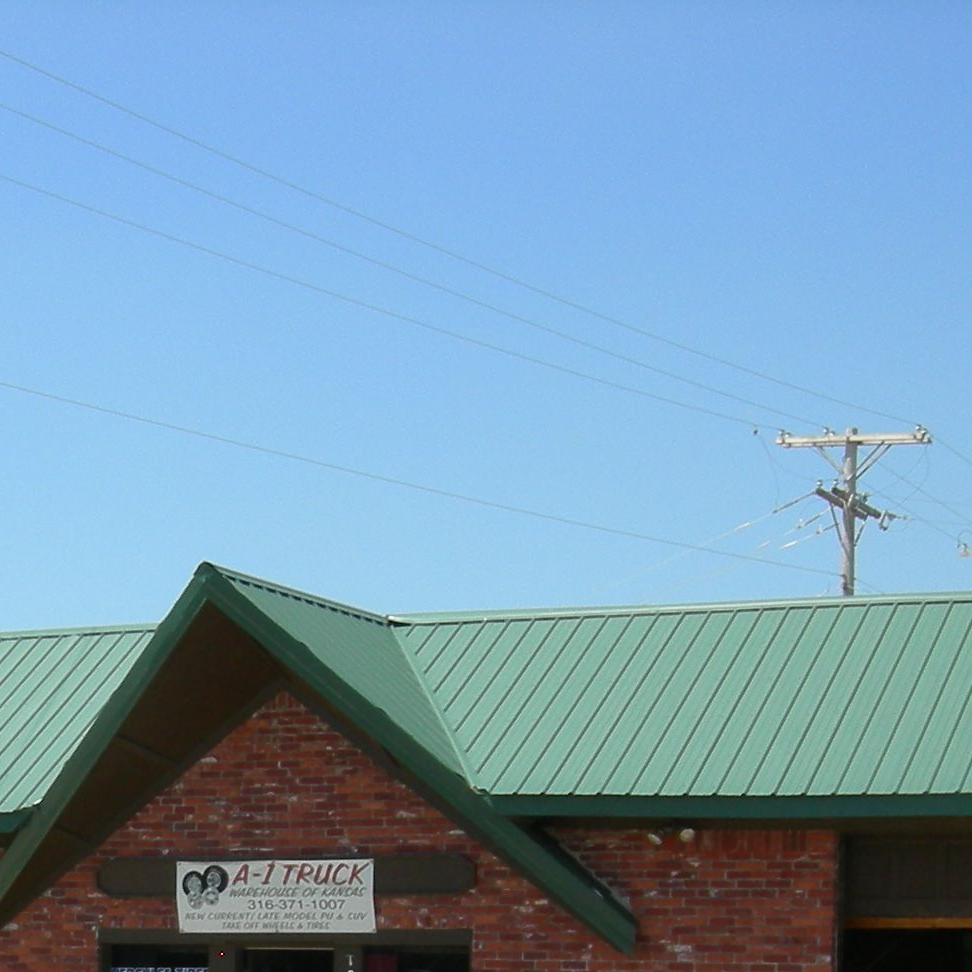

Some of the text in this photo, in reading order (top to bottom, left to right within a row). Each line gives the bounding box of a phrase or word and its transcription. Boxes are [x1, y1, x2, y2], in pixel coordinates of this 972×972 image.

[231, 861, 370, 886] A-1 TRUCK
[229, 887, 367, 898] WAREHOUSE OF KANSAS
[247, 899, 346, 910] 316-371-1007
[184, 912, 205, 921] NEW
[257, 912, 278, 921] LATE
[283, 912, 317, 921] MODEL
[320, 912, 334, 921] PU
[221, 922, 241, 930] TAKE
[243, 922, 260, 930] OFF
[261, 922, 294, 930] WHEELS
[306, 922, 331, 930] TIRES
